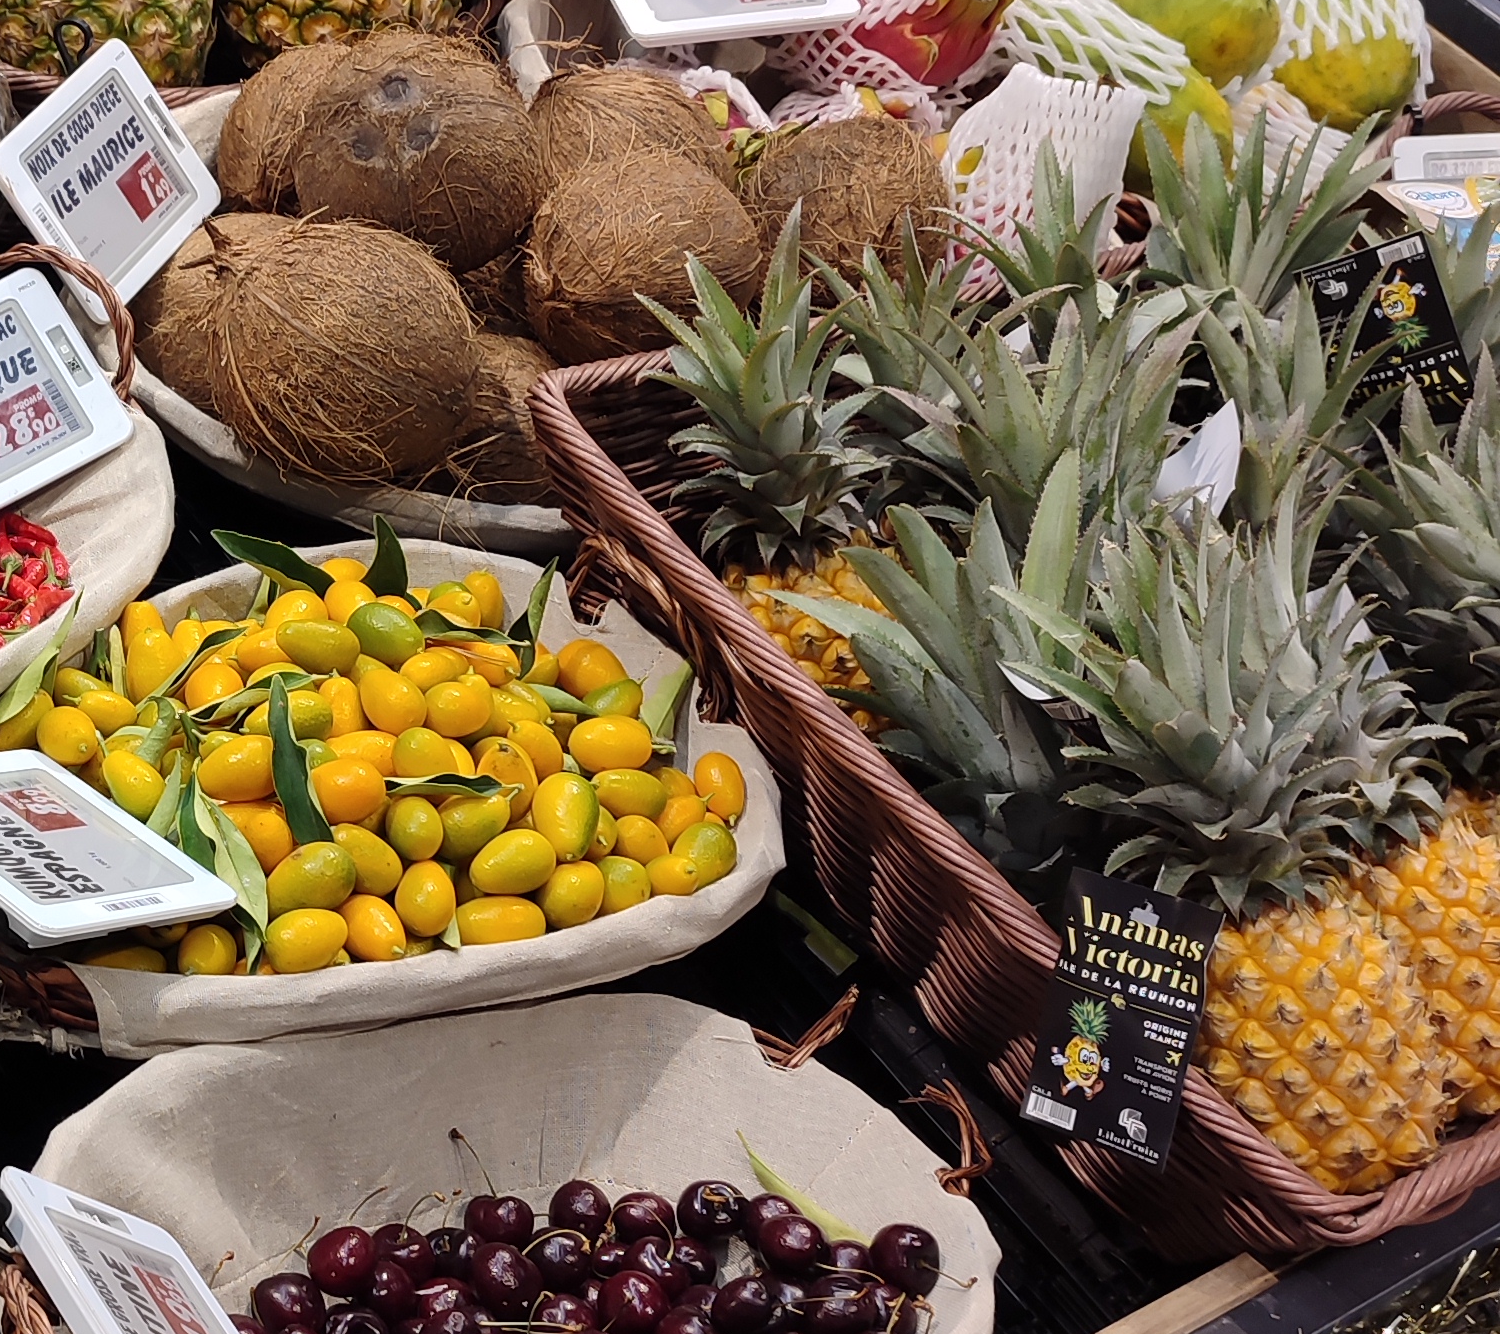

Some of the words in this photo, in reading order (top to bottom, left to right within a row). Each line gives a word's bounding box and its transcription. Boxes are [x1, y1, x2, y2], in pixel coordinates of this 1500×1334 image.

[26, 137, 58, 184] NOIX
[51, 131, 72, 161] DE
[69, 108, 95, 146] COCO
[92, 82, 122, 122] PIECE
[50, 178, 81, 220] ILE
[78, 115, 145, 195] MAURICE
[12, 391, 43, 412] PROMO
[1068, 895, 1205, 963] Ananas
[1065, 925, 1199, 996] Victoria
[1081, 969, 1099, 983] DE
[1104, 976, 1123, 990] LA
[1143, 1019, 1189, 1041] ORIGINE
[1143, 1029, 1187, 1050] FRANCE
[1133, 1055, 1178, 1077] TRANSPORT
[1137, 1065, 1152, 1075] PAR
[1123, 1073, 1149, 1087] FRUITS
[1148, 1090, 1172, 1103] POINT
[58, 1225, 93, 1265] VRAC
[83, 1265, 131, 1323] GROSSE
